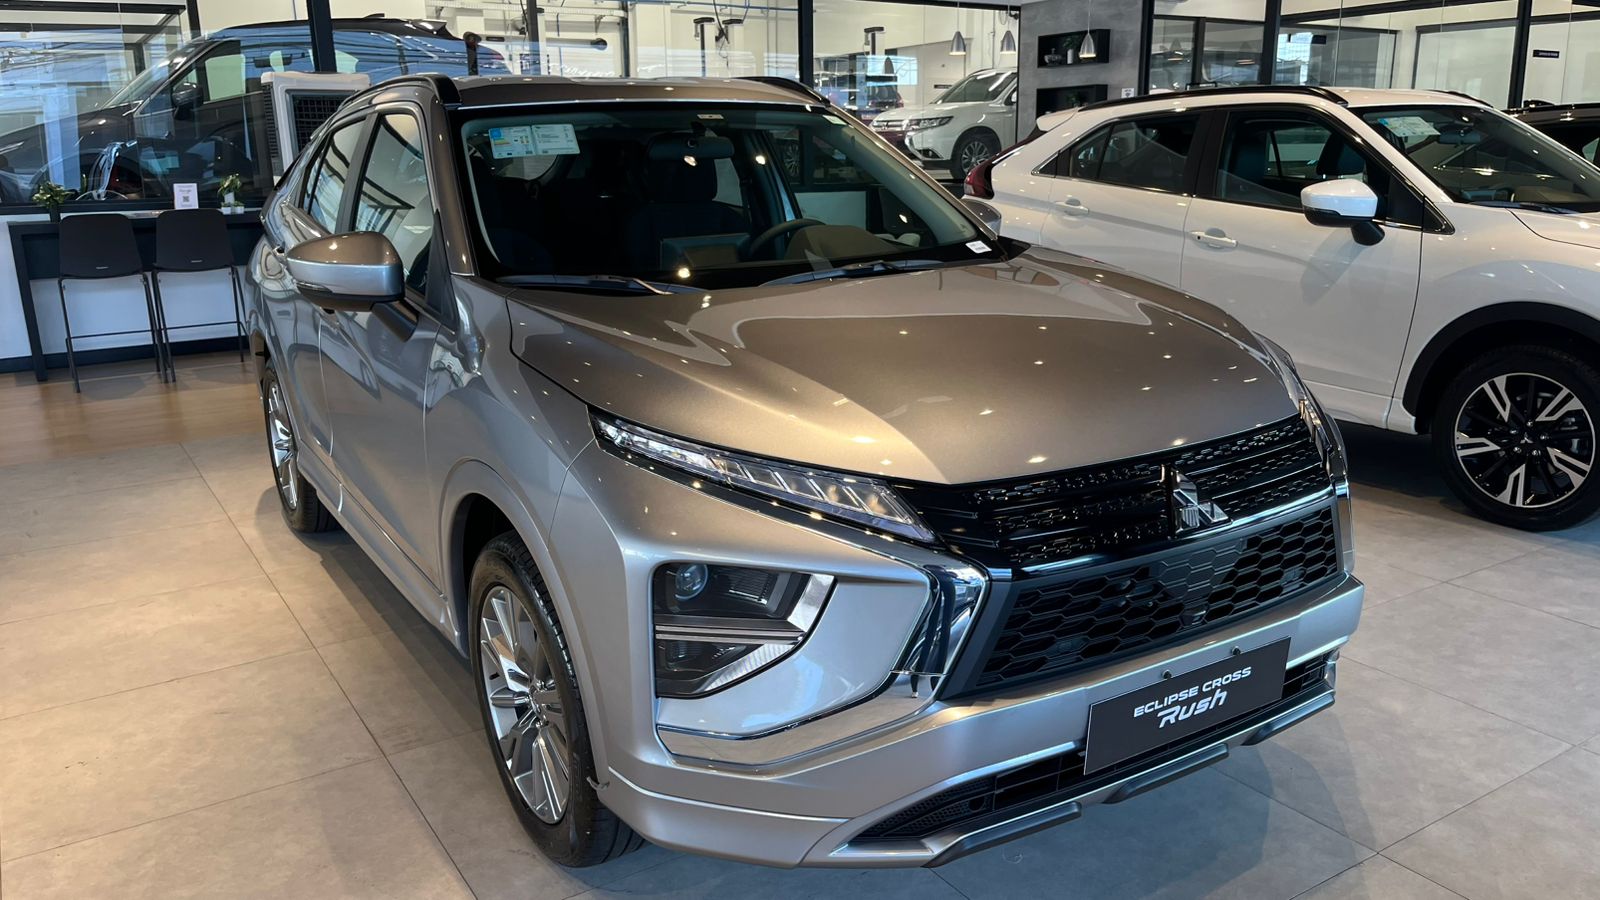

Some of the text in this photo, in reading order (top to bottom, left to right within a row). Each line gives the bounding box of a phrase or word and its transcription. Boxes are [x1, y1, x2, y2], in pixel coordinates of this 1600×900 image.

[1134, 667, 1252, 717] ECLIPSE CROSS
[1157, 689, 1228, 728] Rush
